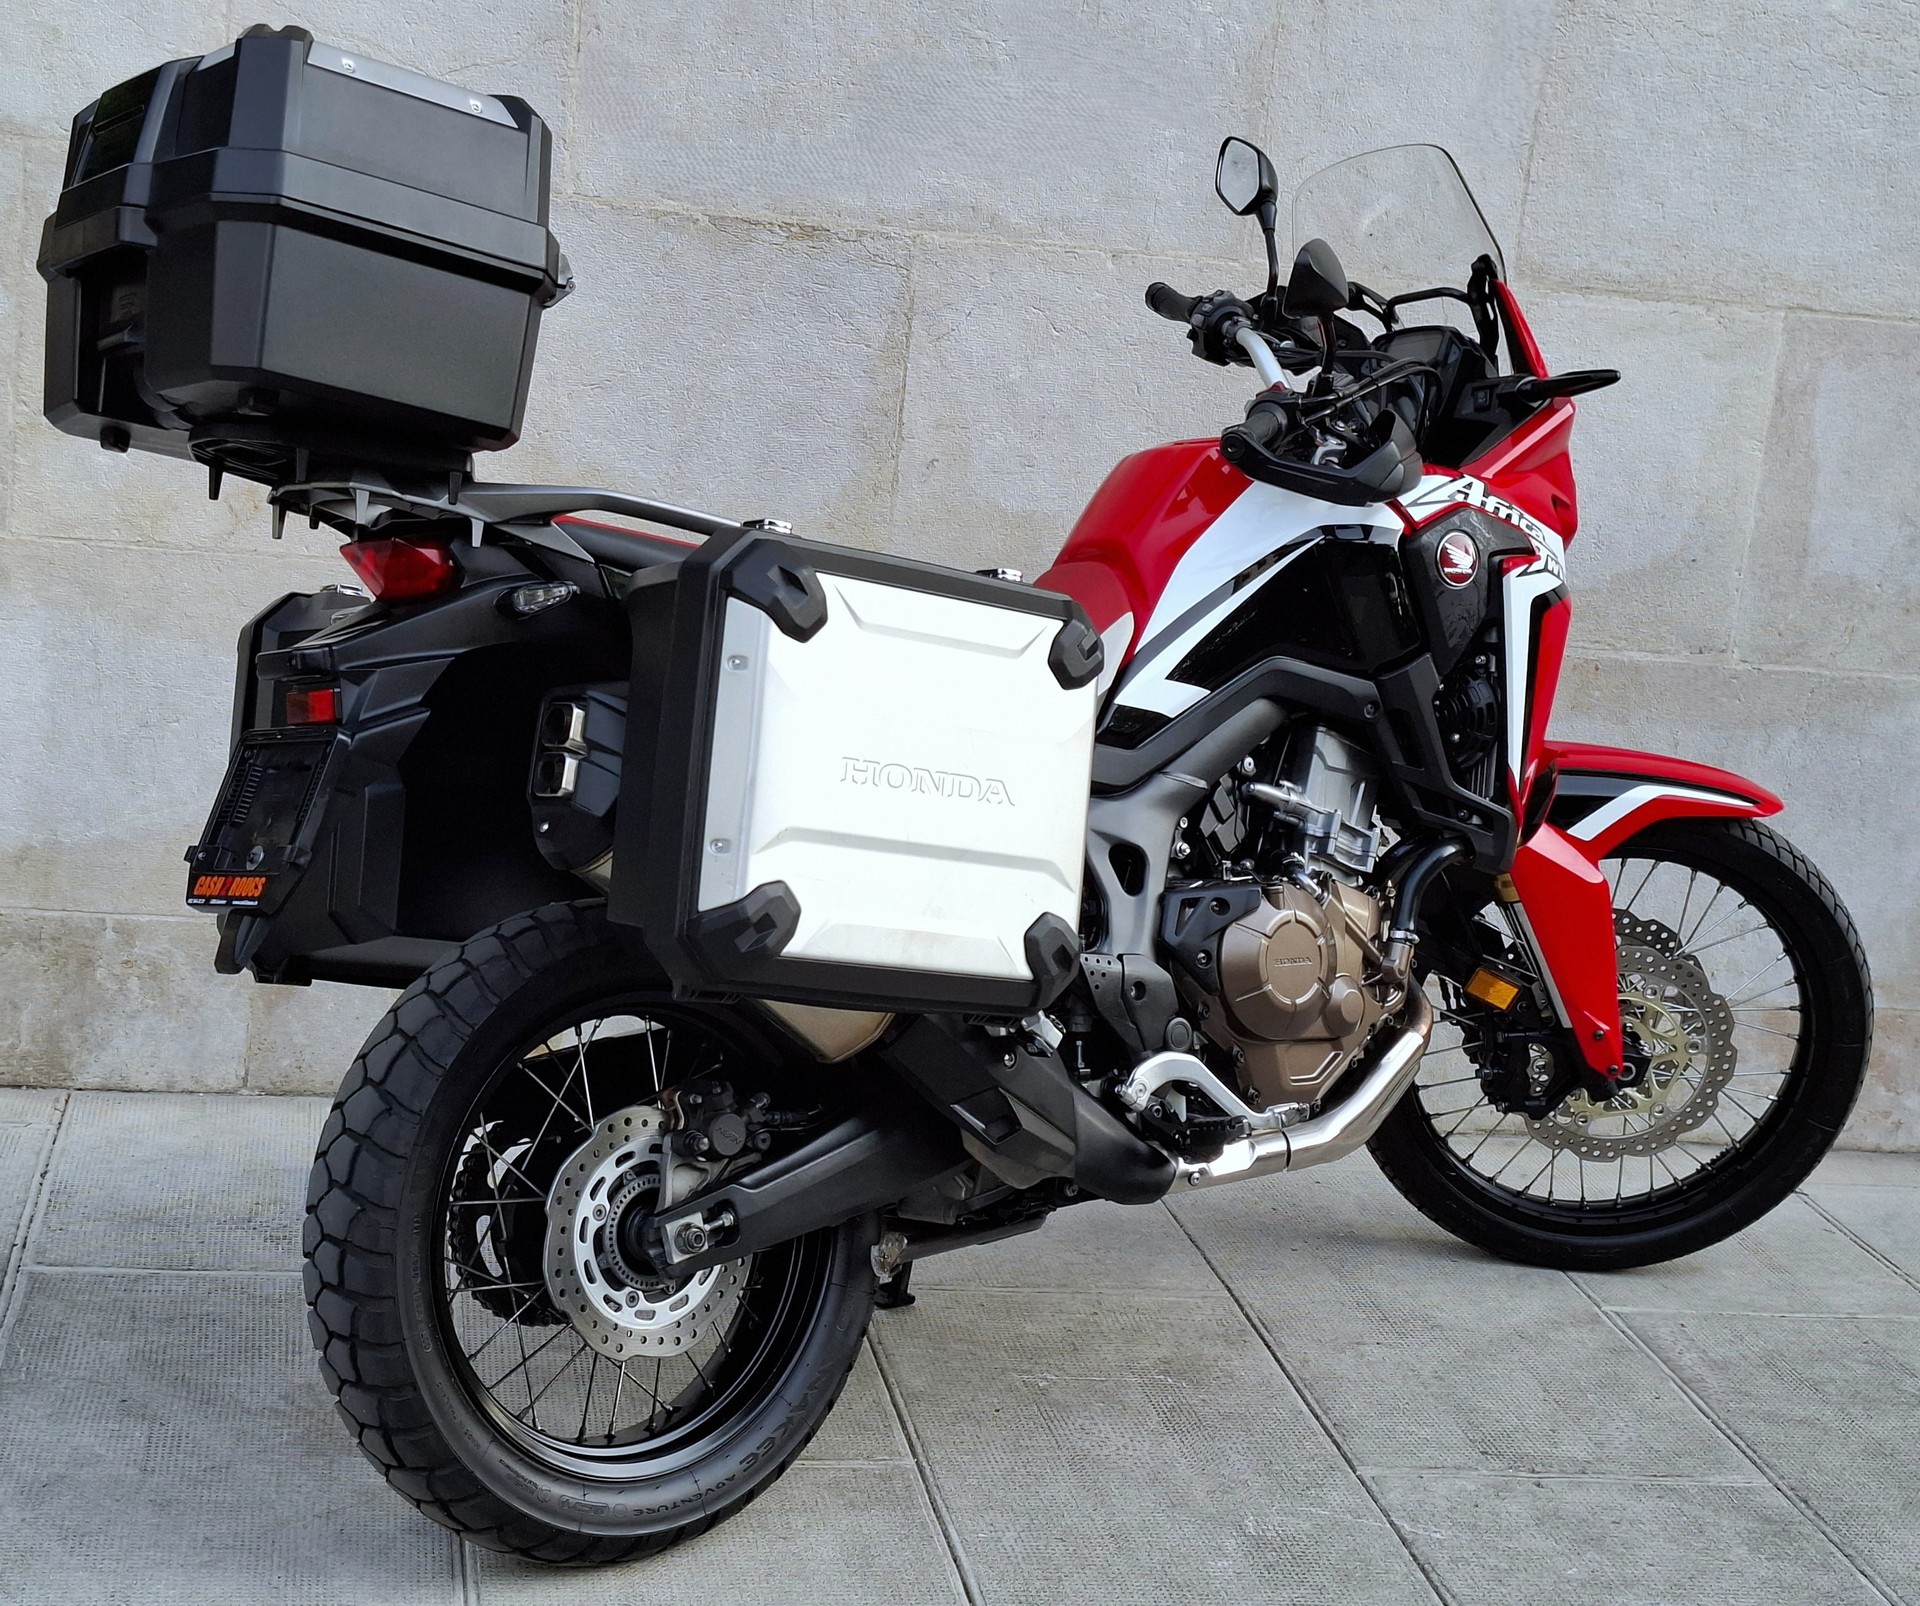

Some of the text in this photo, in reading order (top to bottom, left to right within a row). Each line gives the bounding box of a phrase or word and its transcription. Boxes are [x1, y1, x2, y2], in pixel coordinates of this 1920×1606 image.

[840, 756, 1015, 806] HONDA
[218, 876, 233, 897] 2
[1273, 956, 1313, 967] HONDA
[633, 1474, 736, 1517] ADVENTURE
